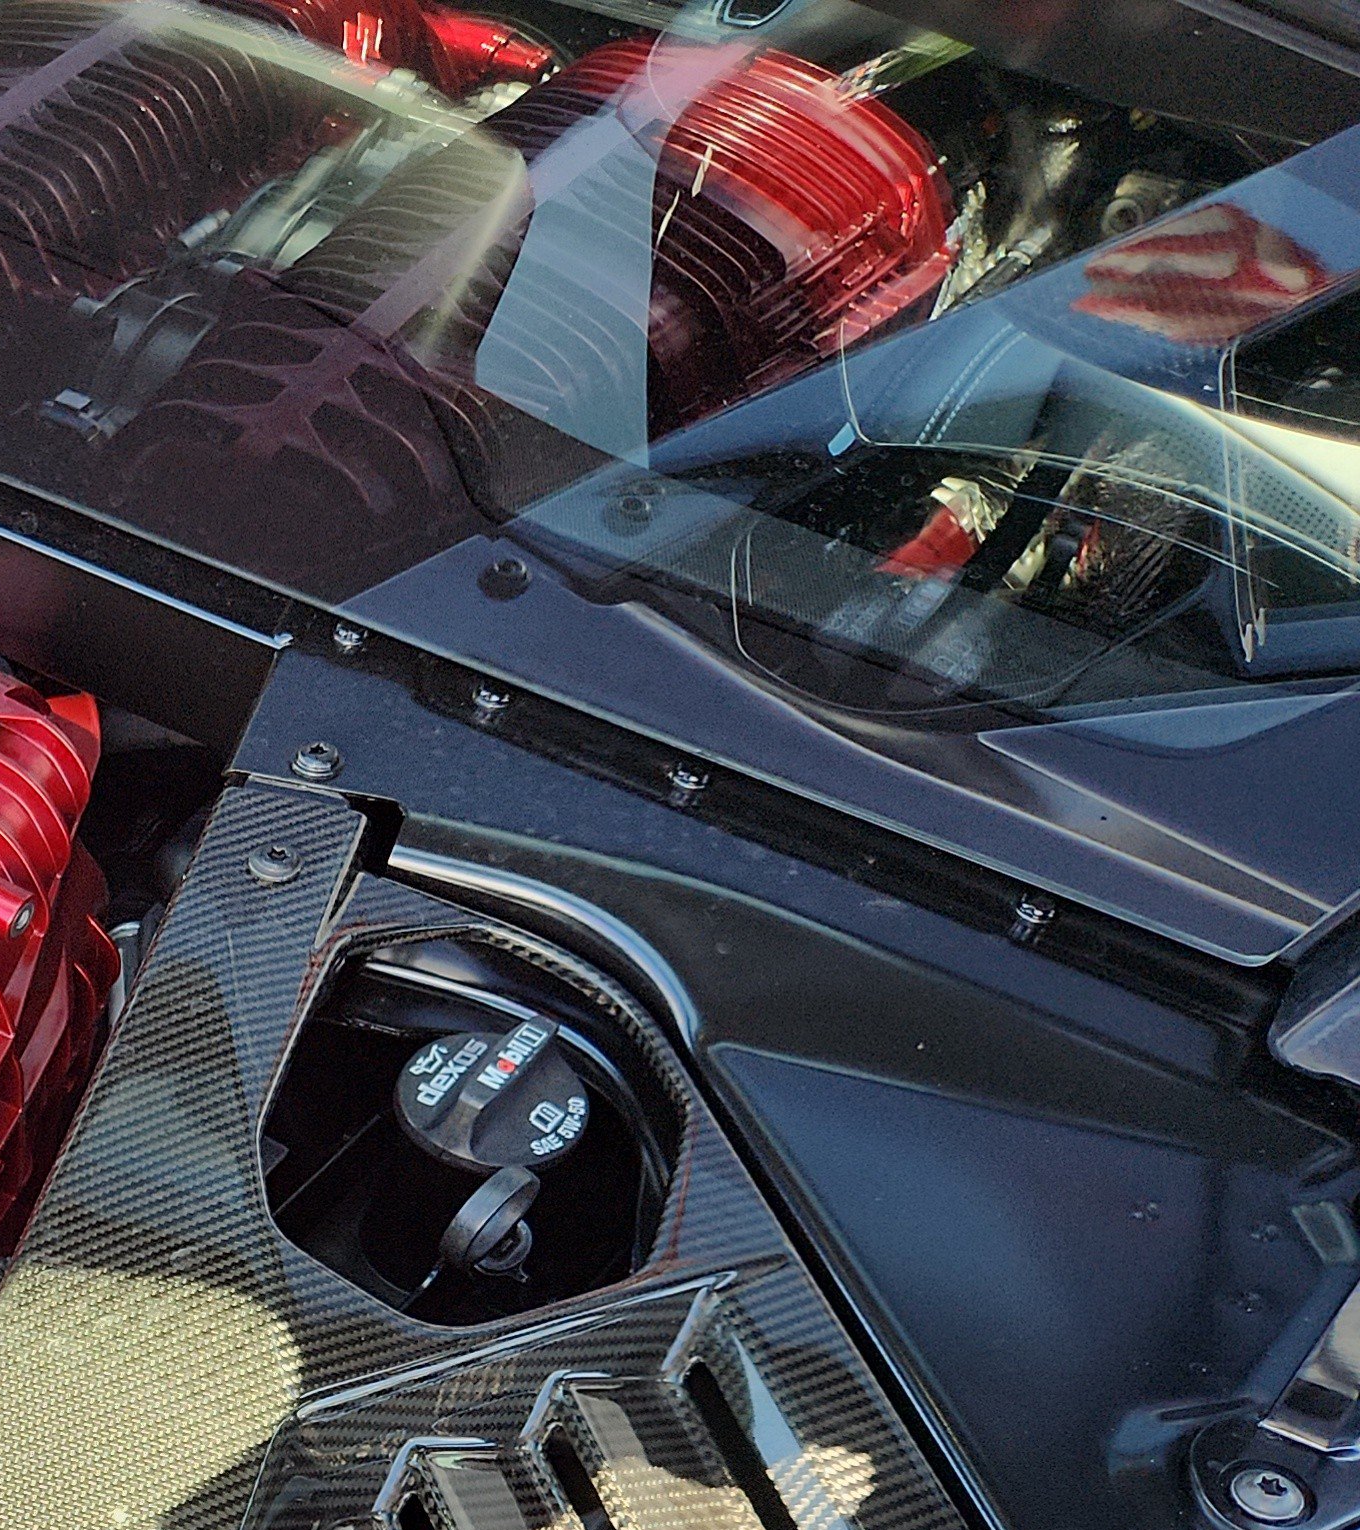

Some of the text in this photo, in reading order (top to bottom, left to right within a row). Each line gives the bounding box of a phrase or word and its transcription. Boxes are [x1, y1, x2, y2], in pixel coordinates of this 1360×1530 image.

[416, 1038, 488, 1106] dexos
[477, 1036, 532, 1090] Mobil
[530, 1132, 564, 1156] SAE
